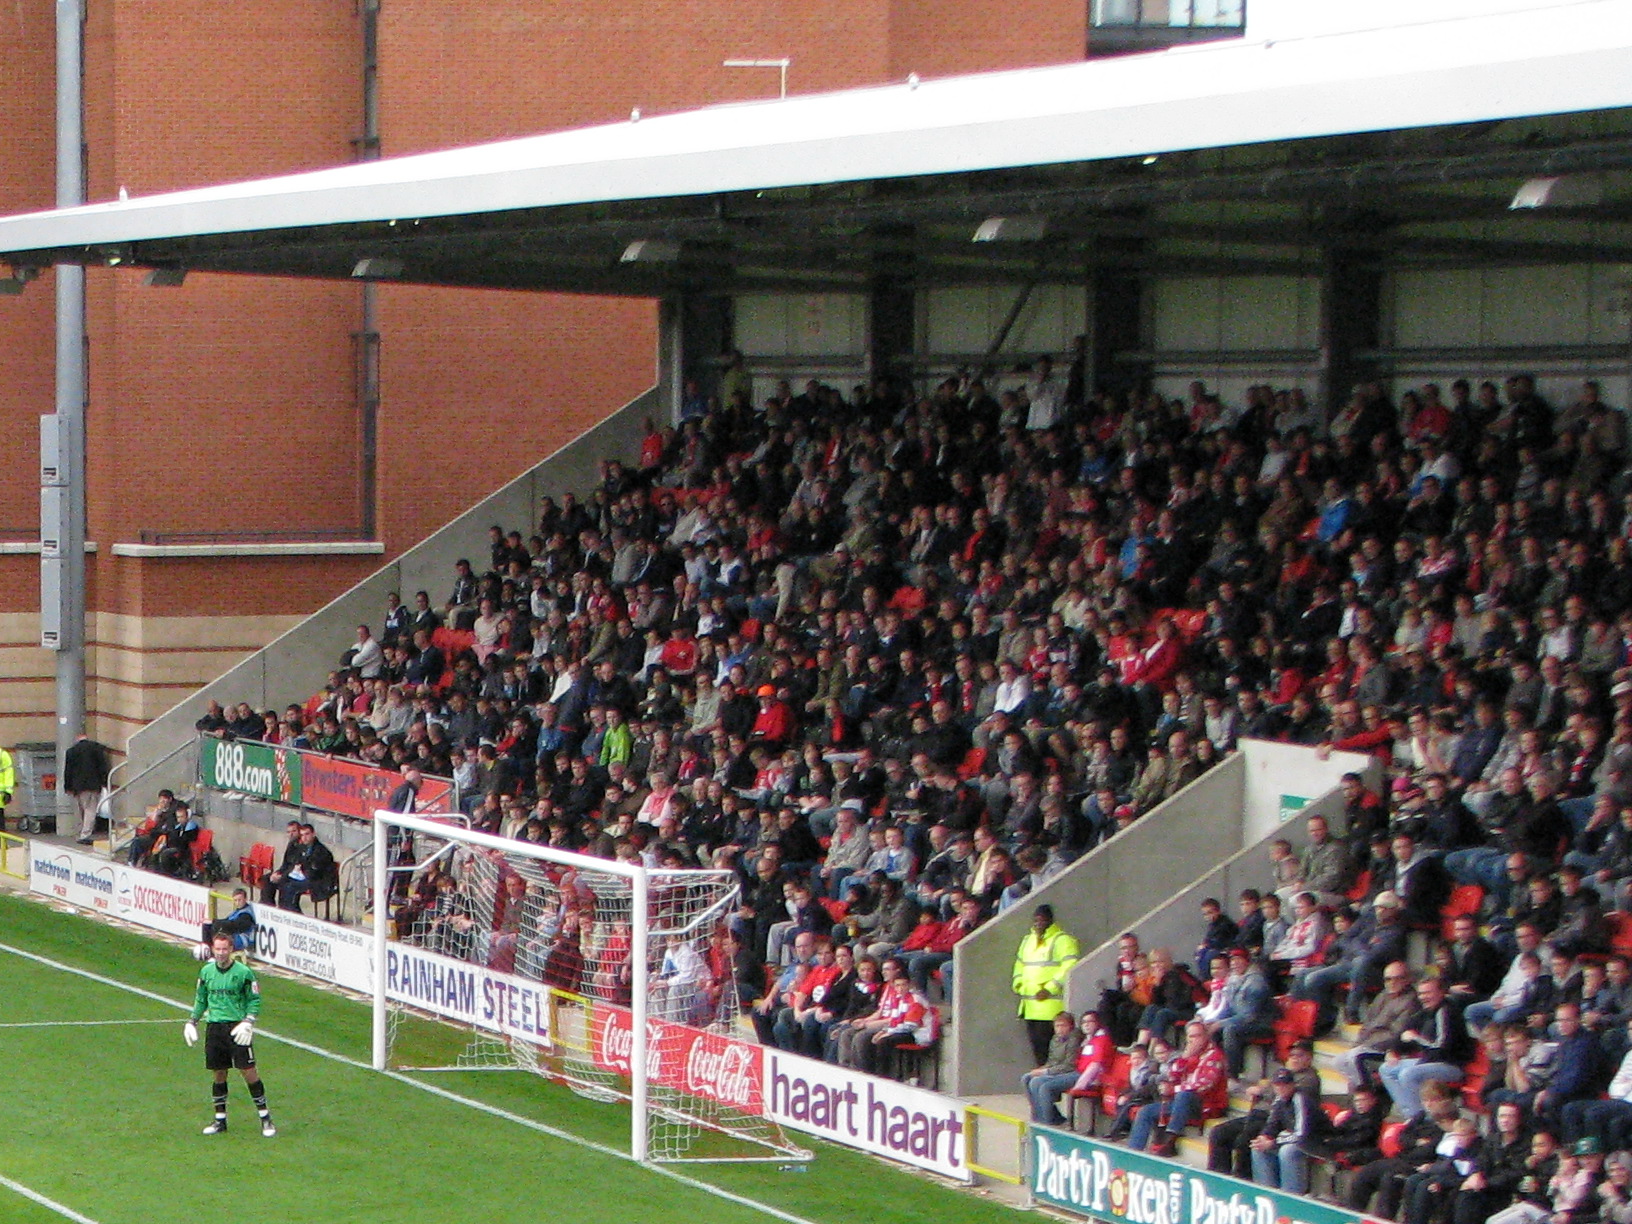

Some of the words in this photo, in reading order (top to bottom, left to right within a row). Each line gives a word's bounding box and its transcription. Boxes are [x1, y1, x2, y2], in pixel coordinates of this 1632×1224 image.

[215, 742, 273, 796] 888.com
[34, 859, 71, 882] matchroom
[75, 871, 113, 895] matchroom
[134, 885, 207, 926] SOCCERSCENE.CO.UK
[387, 949, 475, 1015] RAINHAM
[482, 976, 548, 1037] STEEL
[771, 1056, 858, 1137] haart
[867, 1082, 963, 1168] haart
